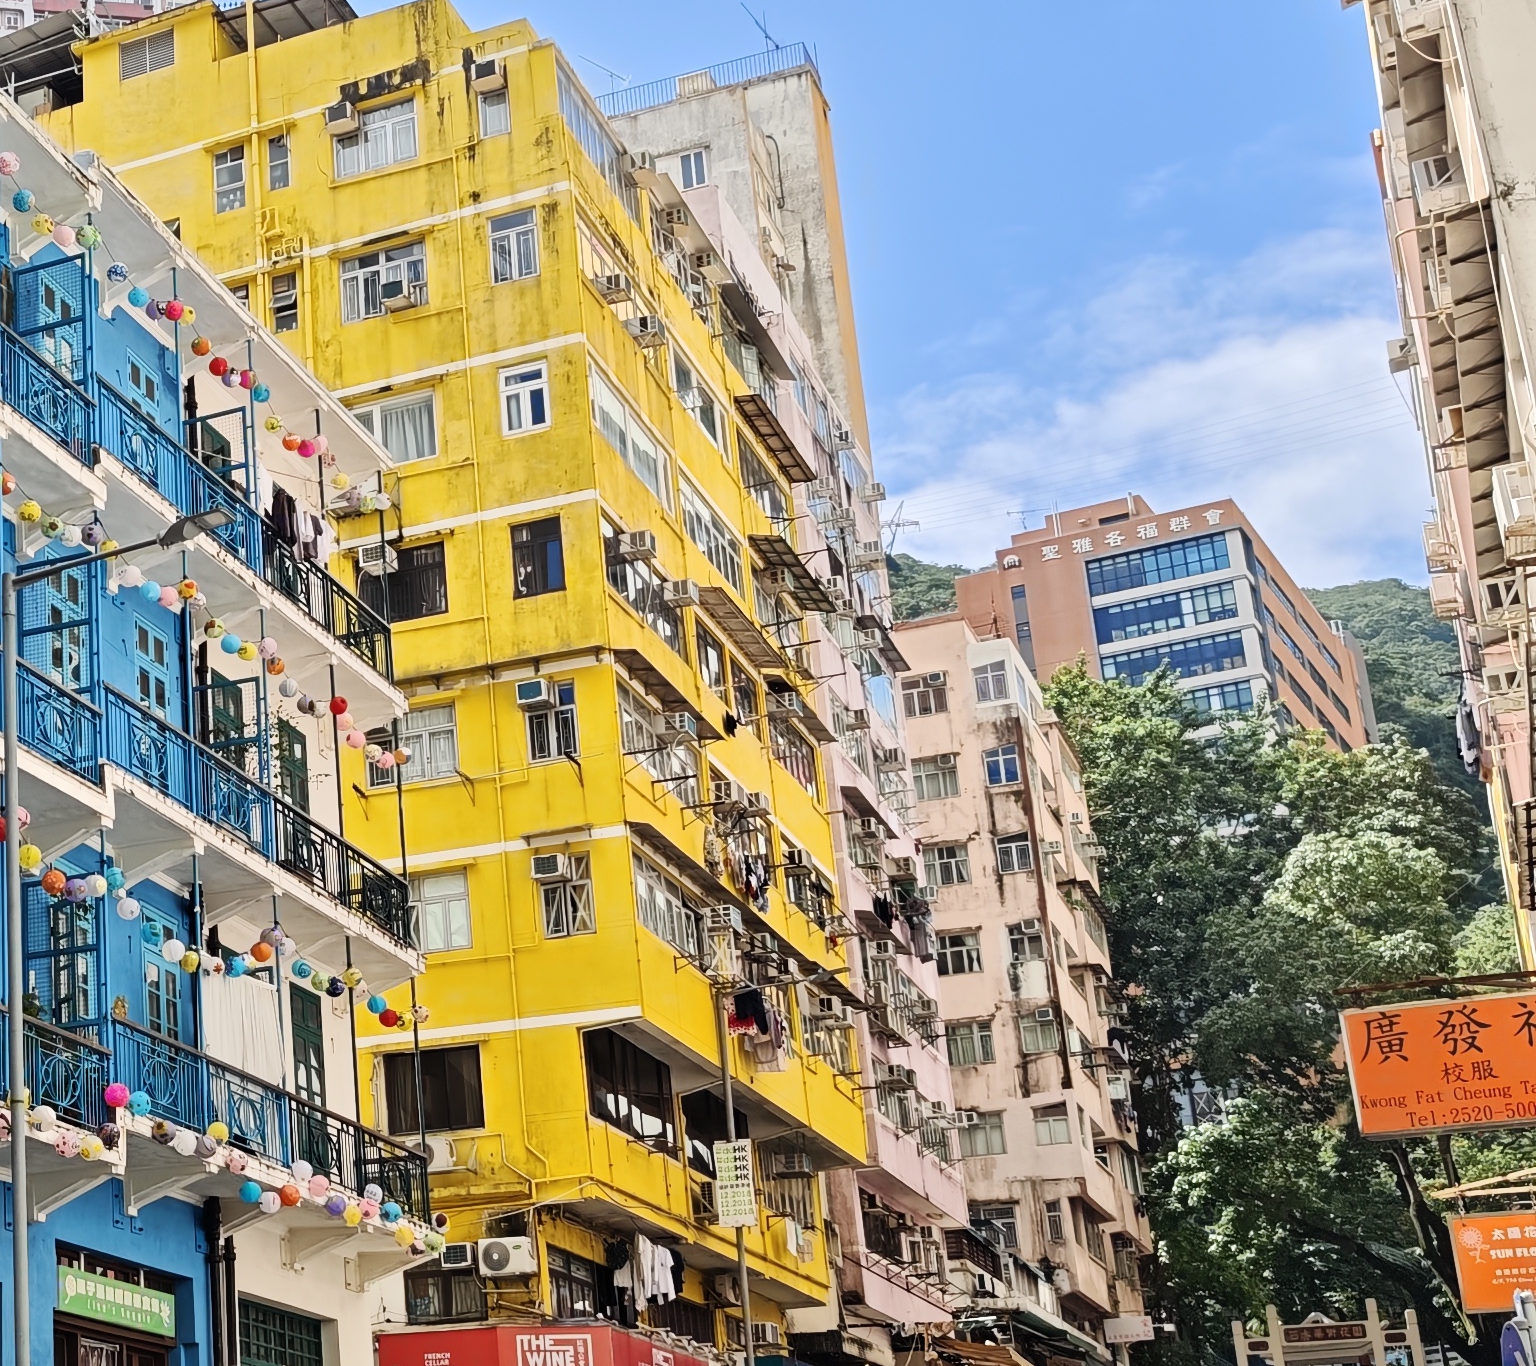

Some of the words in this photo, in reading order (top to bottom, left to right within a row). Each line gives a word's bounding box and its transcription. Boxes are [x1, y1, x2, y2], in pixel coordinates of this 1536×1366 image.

[1041, 508, 1225, 562] 聖雅各福群會
[1440, 1059, 1500, 1085] 校服
[1359, 1094, 1408, 1110] Kwong
[1416, 1090, 1445, 1105] Fat
[1453, 1085, 1513, 1102] Cheung
[521, 1335, 554, 1351] THE
[424, 1352, 451, 1360] FRENCH
[424, 1359, 449, 1366] CELLAR
[526, 1352, 575, 1366] WINE
